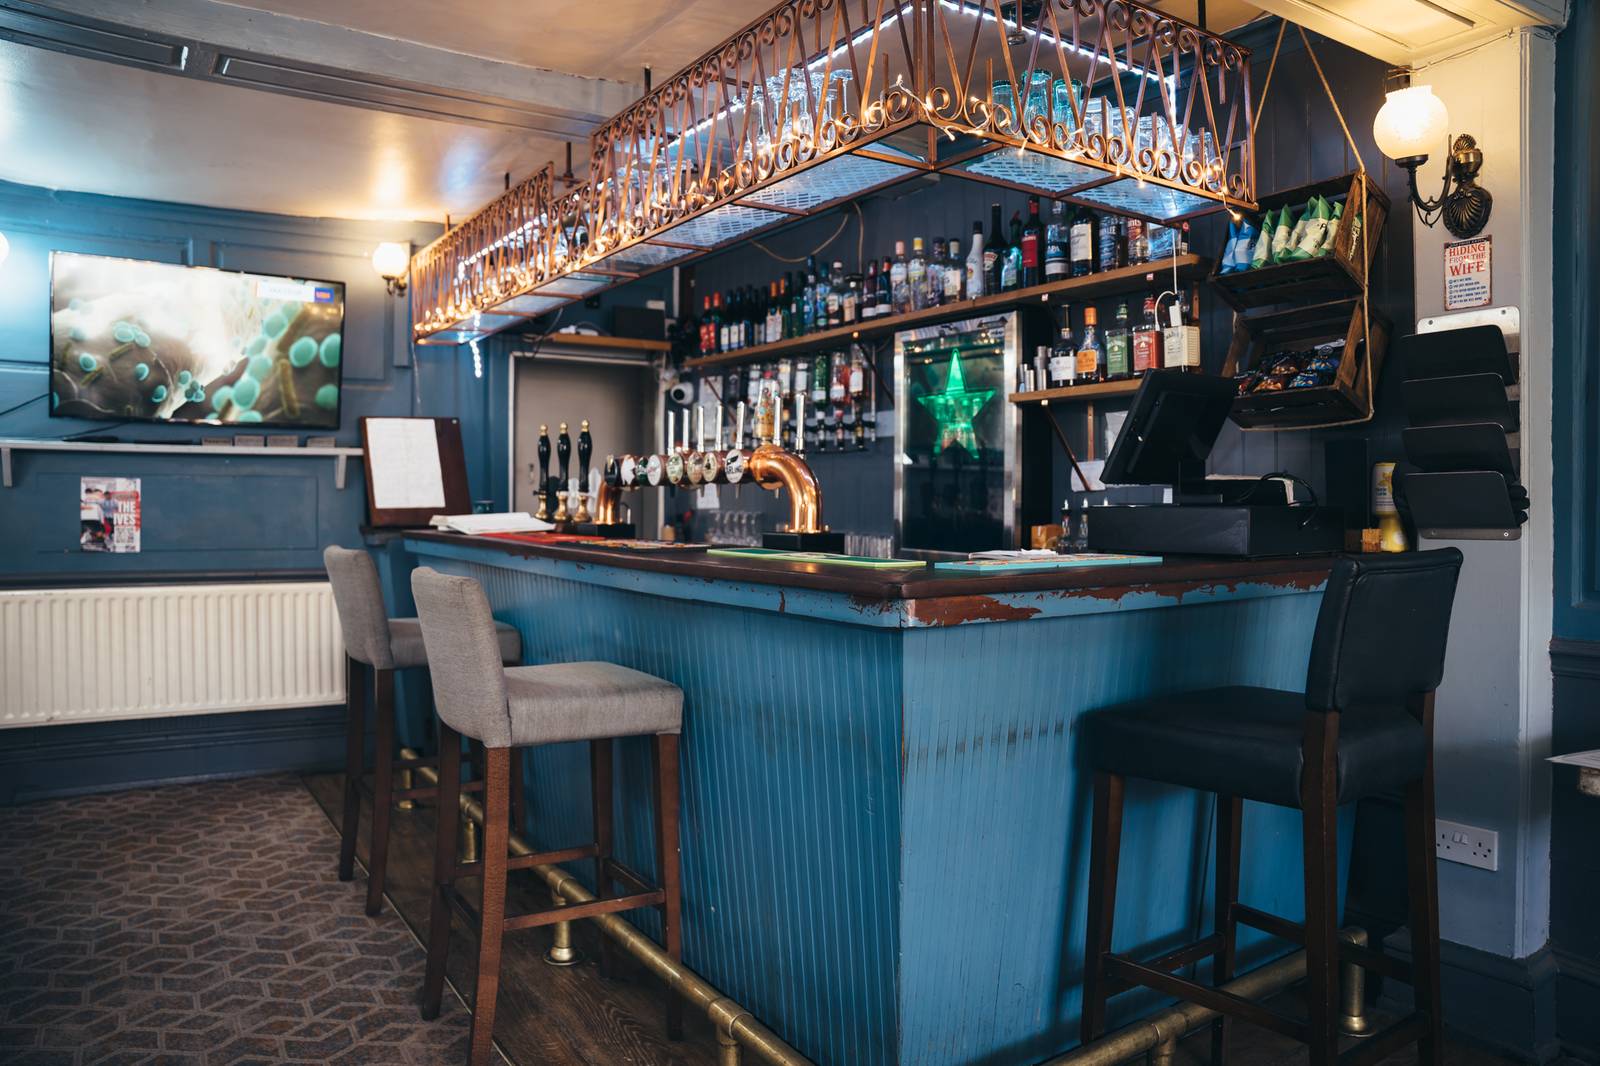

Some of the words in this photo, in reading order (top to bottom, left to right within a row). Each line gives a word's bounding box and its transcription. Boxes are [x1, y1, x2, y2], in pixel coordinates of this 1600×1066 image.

[1449, 243, 1486, 257] HIDING
[1449, 255, 1470, 264] FROM
[1470, 252, 1486, 261] THE
[1450, 260, 1486, 276] WIFE
[117, 500, 136, 513] THE
